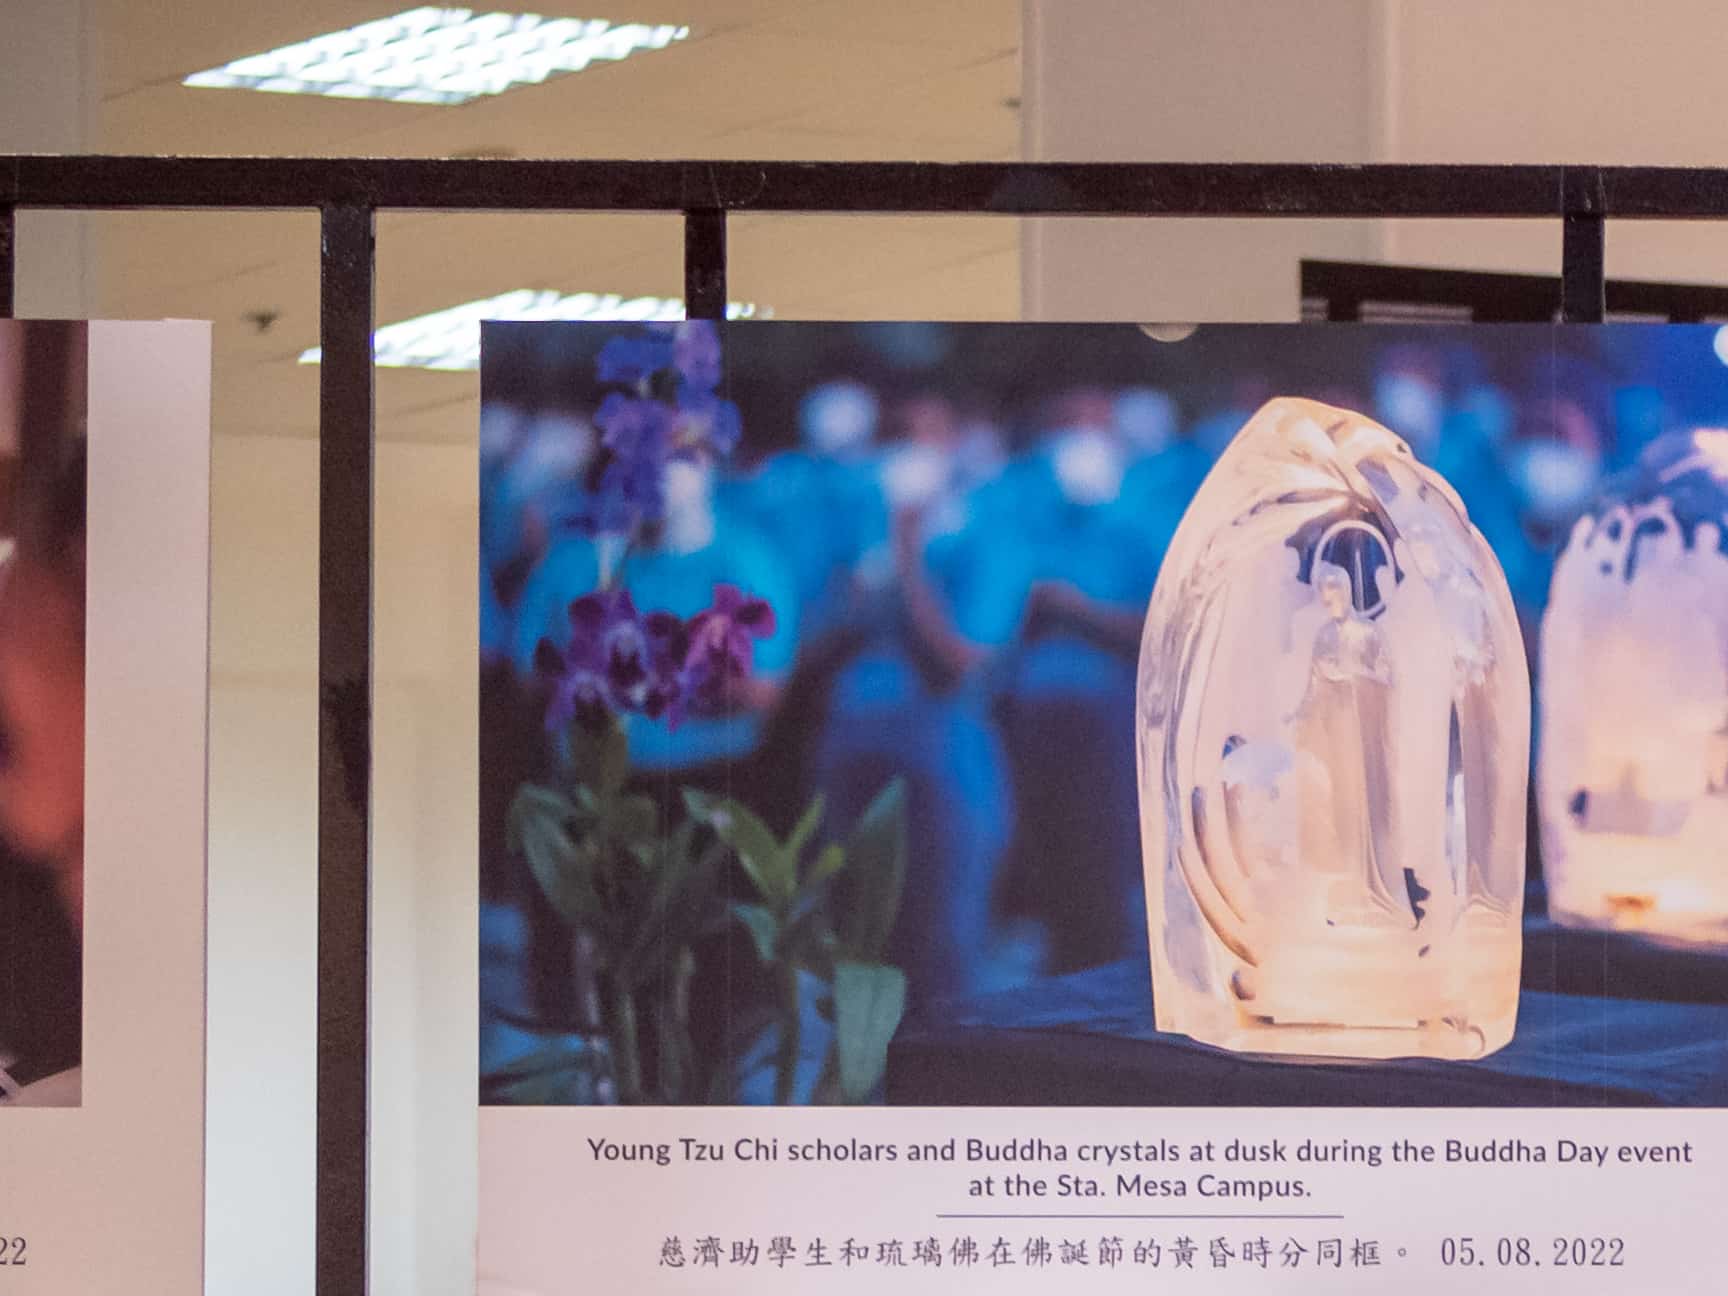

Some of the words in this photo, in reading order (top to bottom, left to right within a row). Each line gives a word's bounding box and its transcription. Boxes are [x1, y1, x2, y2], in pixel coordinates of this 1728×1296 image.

[587, 1137, 671, 1167] Young
[678, 1137, 724, 1161] Tzu
[734, 1137, 778, 1161] Chi
[787, 1137, 898, 1162] scholars
[906, 1137, 956, 1162] and
[966, 1137, 1068, 1162] Buddha
[1077, 1138, 1180, 1167] crystals
[1189, 1140, 1215, 1162] at
[1224, 1138, 1287, 1163] dusk
[1296, 1138, 1383, 1168] during
[1391, 1138, 1436, 1163] the
[1445, 1138, 1547, 1163] Buddha
[1557, 1139, 1609, 1168] Day
[1617, 1141, 1693, 1163] event
[968, 1175, 995, 1197] at
[1003, 1173, 1048, 1197] the
[1057, 1173, 1106, 1197] Sta.
[1116, 1173, 1187, 1197] Mesa
[1196, 1173, 1312, 1202] Campus.
[659, 1235, 1407, 1270] 慈濟助學生和琉璃佛在佛誕節的黃昏時分同框。
[1440, 1237, 1625, 1267] 05.08.2022
